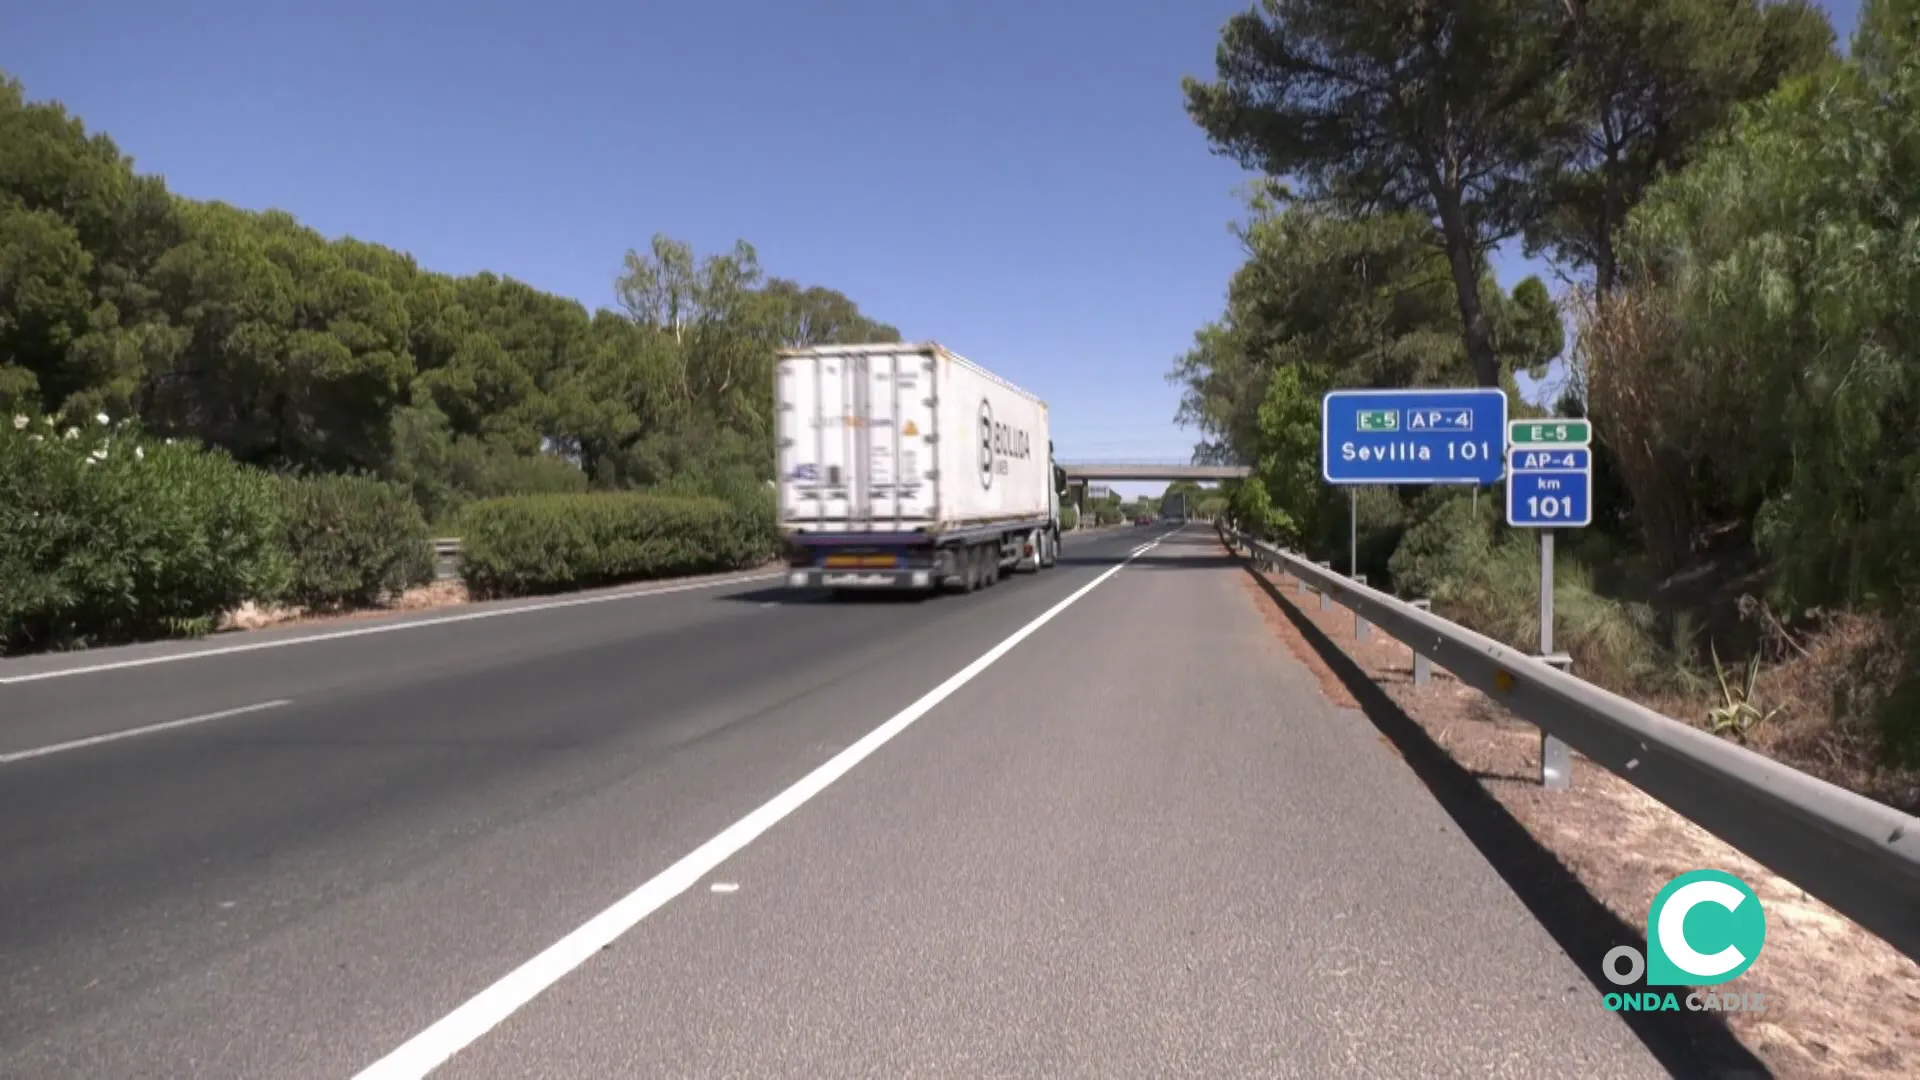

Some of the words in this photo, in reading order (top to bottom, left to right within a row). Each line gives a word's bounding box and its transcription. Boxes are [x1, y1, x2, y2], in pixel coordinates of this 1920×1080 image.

[1360, 411, 1396, 429] E-5
[1412, 411, 1469, 428] AP-4
[1531, 424, 1567, 441] E-5
[1341, 440, 1431, 462] Sevilla
[1448, 440, 1489, 461] 101
[1524, 452, 1575, 469] AP-4
[1538, 476, 1560, 490] km
[1527, 495, 1572, 518] 101
